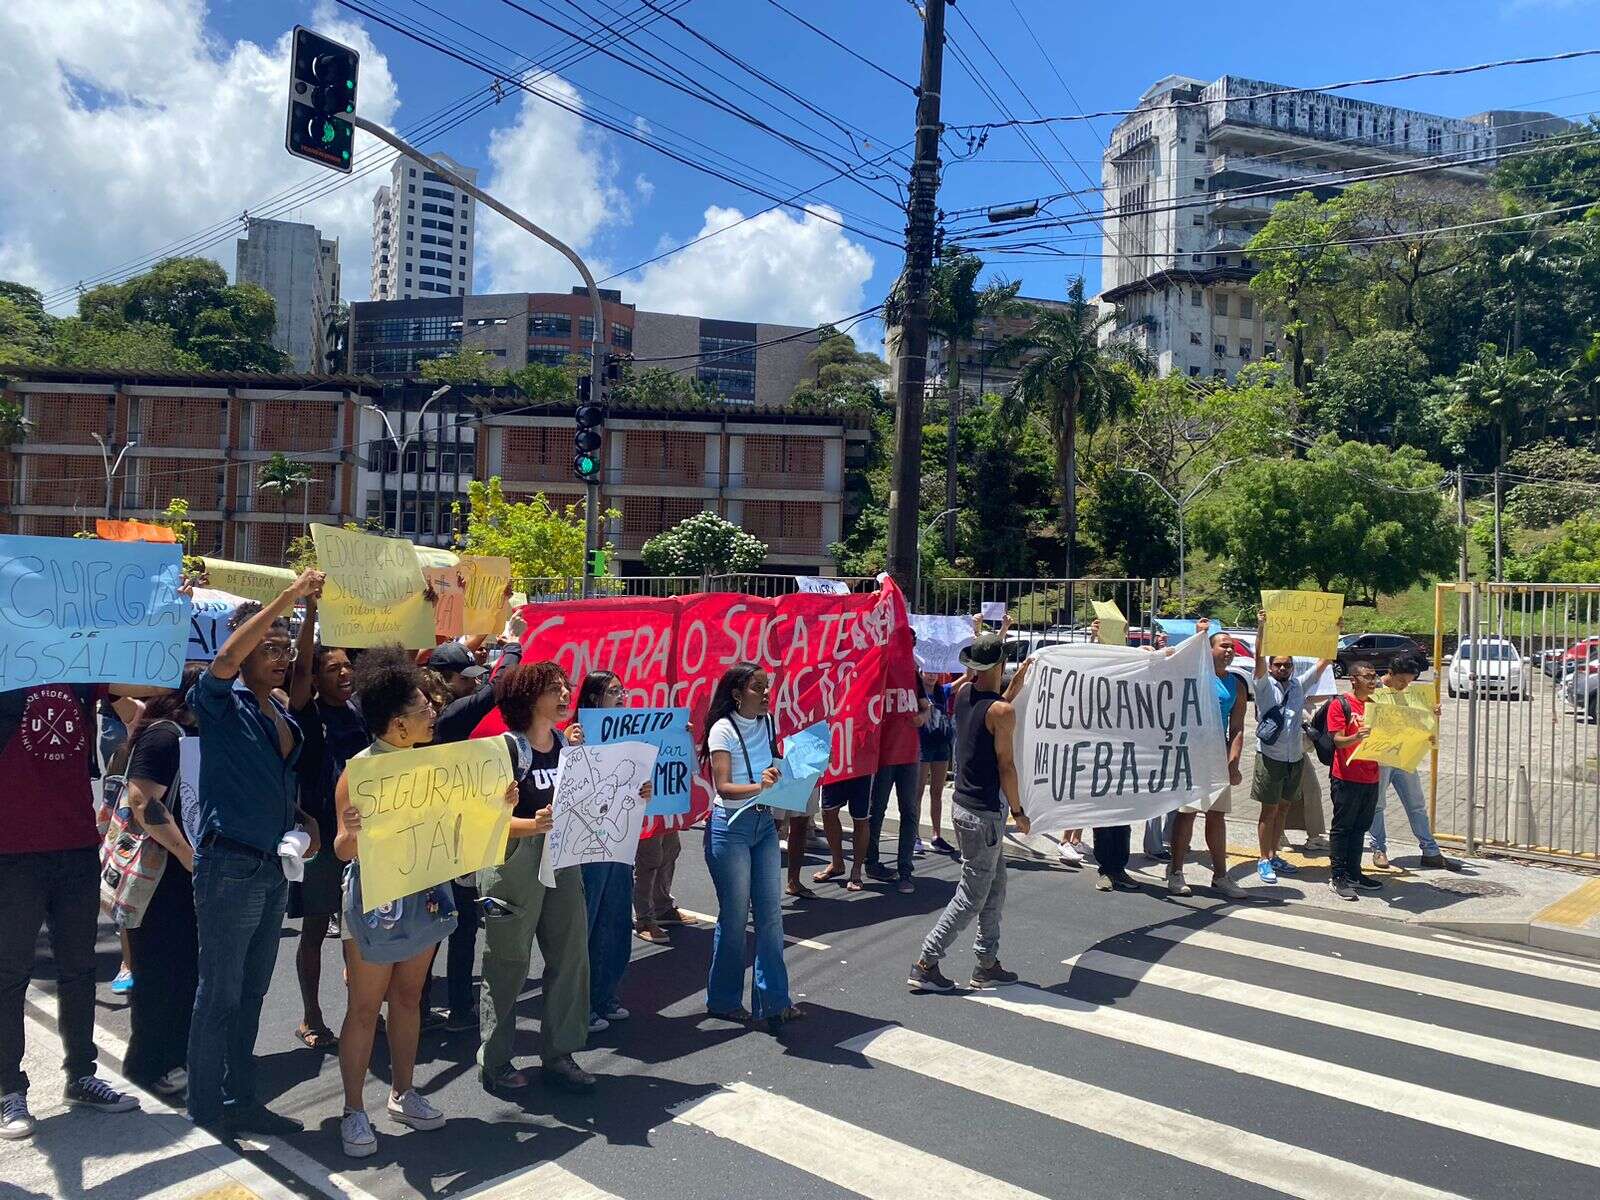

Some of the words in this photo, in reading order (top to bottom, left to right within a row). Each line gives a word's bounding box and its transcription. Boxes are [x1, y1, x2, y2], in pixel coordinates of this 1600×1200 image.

[0, 555, 182, 630] CHEGA
[1268, 593, 1307, 612] CHEGA
[1313, 597, 1338, 613] DE
[70, 631, 100, 639] DE
[682, 619, 708, 675] O
[601, 711, 674, 743] DIREITO
[1035, 665, 1202, 742] SEGURANÇA
[355, 757, 509, 820] SEGURANÇA
[653, 760, 688, 796] MER
[1034, 741, 1049, 776] NA
[1051, 741, 1139, 802] UFBA
[1148, 731, 1193, 793] JÁ
[396, 812, 463, 876] JÁ!
